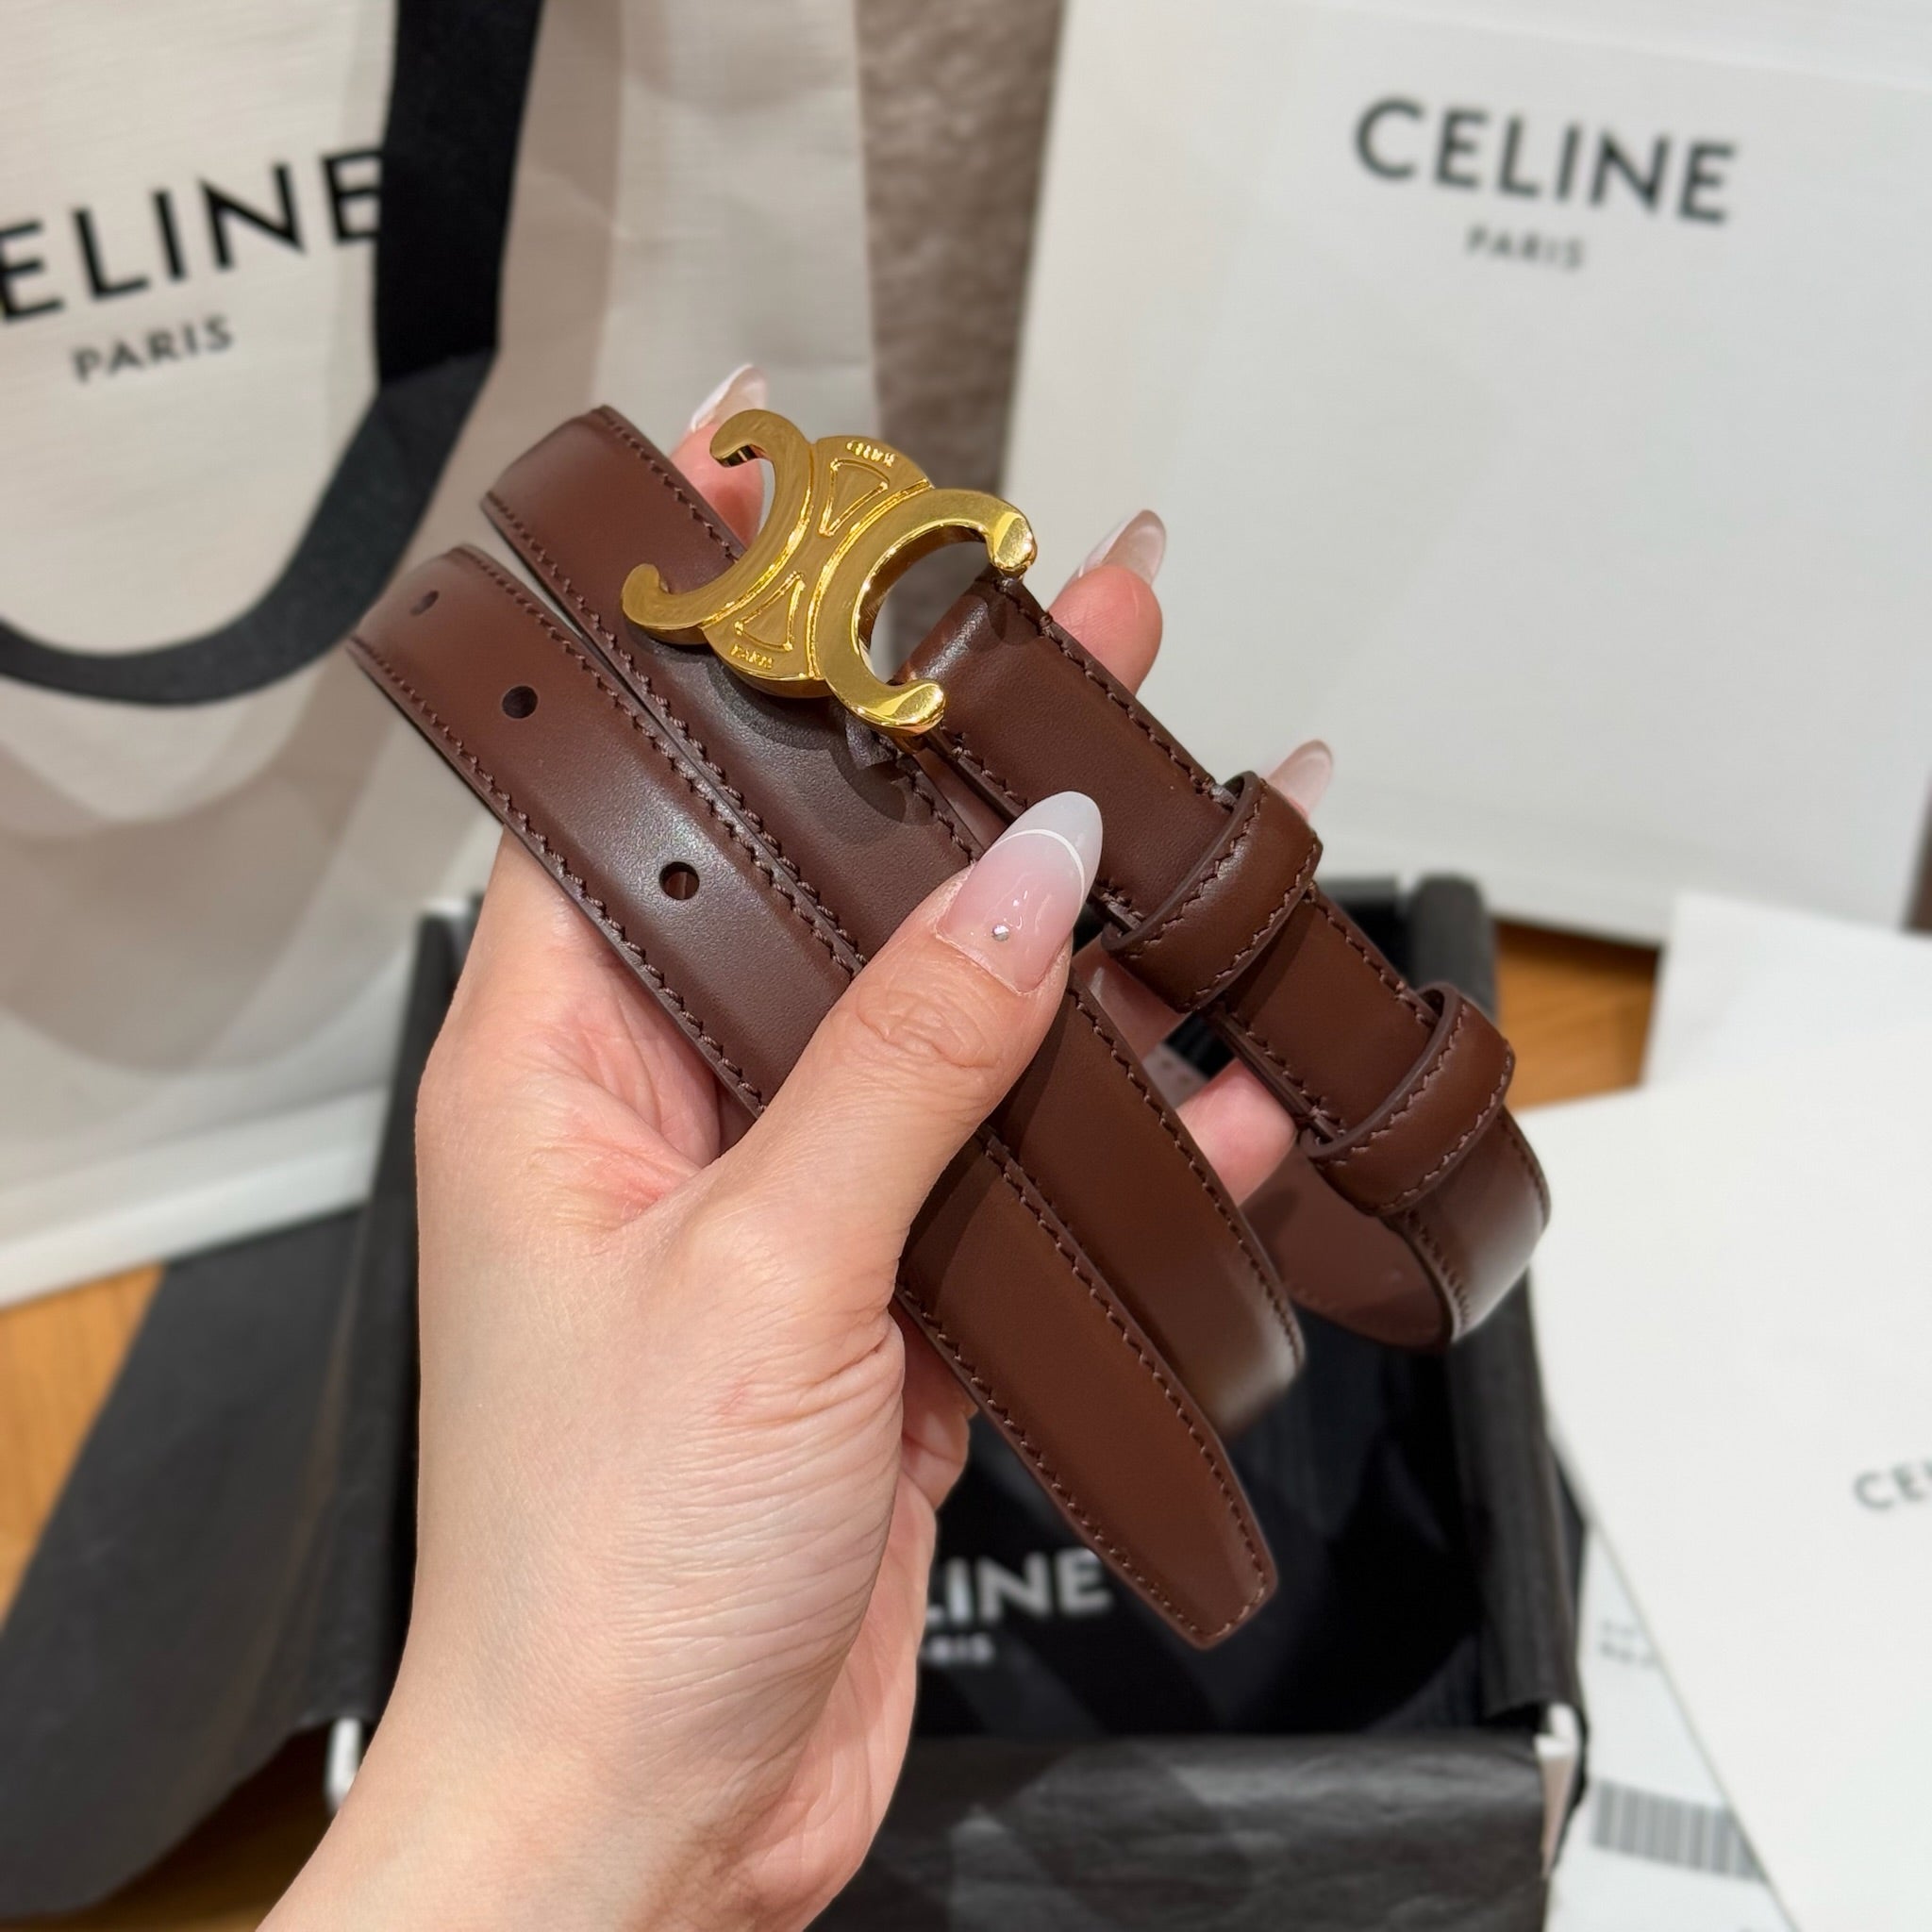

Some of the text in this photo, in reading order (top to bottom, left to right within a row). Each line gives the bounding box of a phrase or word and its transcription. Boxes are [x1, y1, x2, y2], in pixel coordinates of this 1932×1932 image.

[1353, 94, 1737, 225] CELINE
[1467, 223, 1585, 270] PARIS
[72, 313, 233, 381] PARIS
[925, 1546, 1113, 1625] INE
